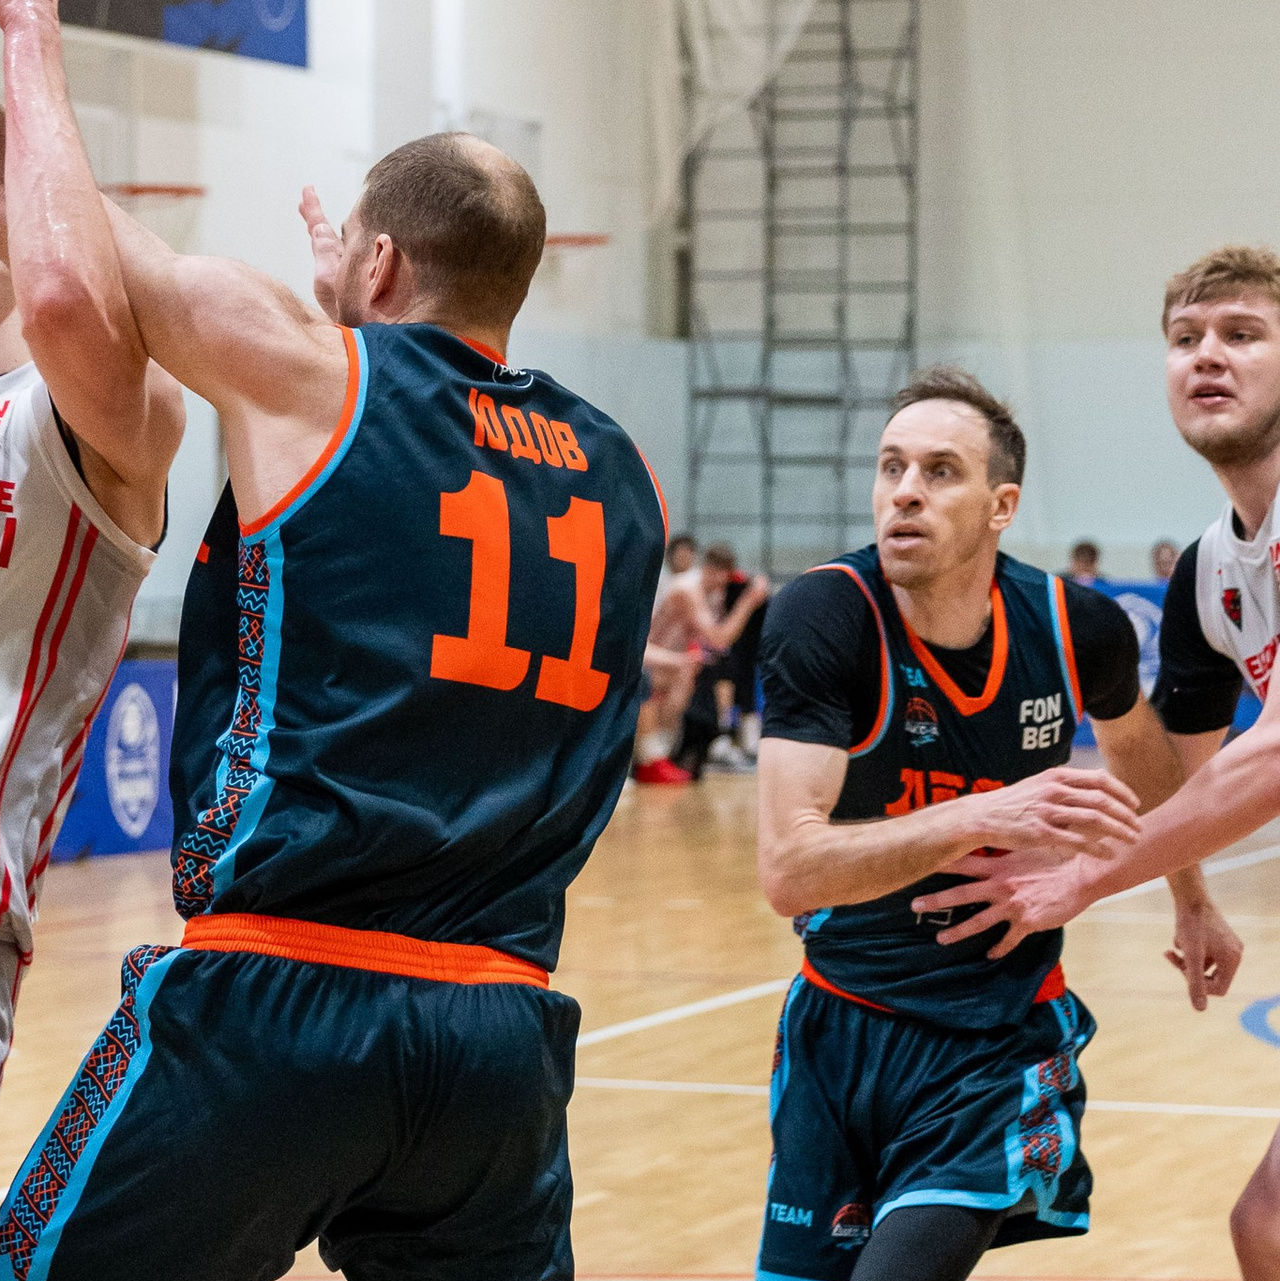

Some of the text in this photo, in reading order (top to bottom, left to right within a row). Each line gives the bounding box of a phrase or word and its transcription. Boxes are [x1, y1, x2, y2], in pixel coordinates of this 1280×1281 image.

[469, 387, 588, 472] ЮДОВ
[430, 470, 610, 712] 11
[1020, 693, 1062, 724] FON
[1021, 718, 1064, 750] BET
[770, 1202, 813, 1228] TEAM
